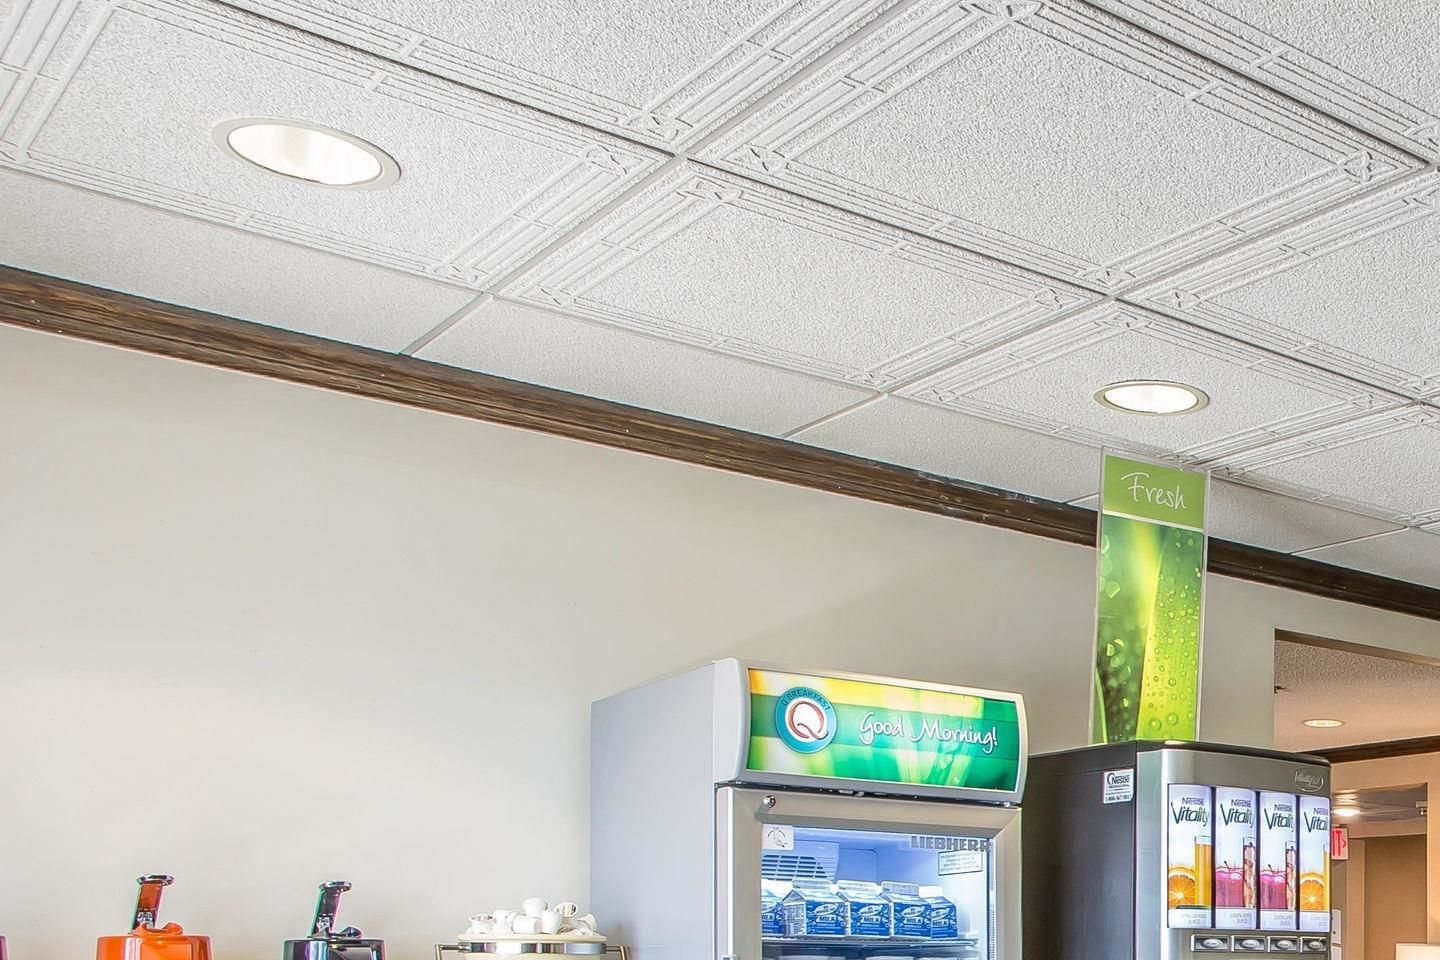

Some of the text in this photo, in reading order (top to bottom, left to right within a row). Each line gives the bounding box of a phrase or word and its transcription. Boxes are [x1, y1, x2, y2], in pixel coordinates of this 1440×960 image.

[1120, 472, 1187, 510] Fresh
[786, 688, 832, 711] BREAKFAST
[859, 711, 999, 754] Good Morning!
[1170, 801, 1209, 827] Vitality
[911, 835, 991, 853] LIEBHERR
